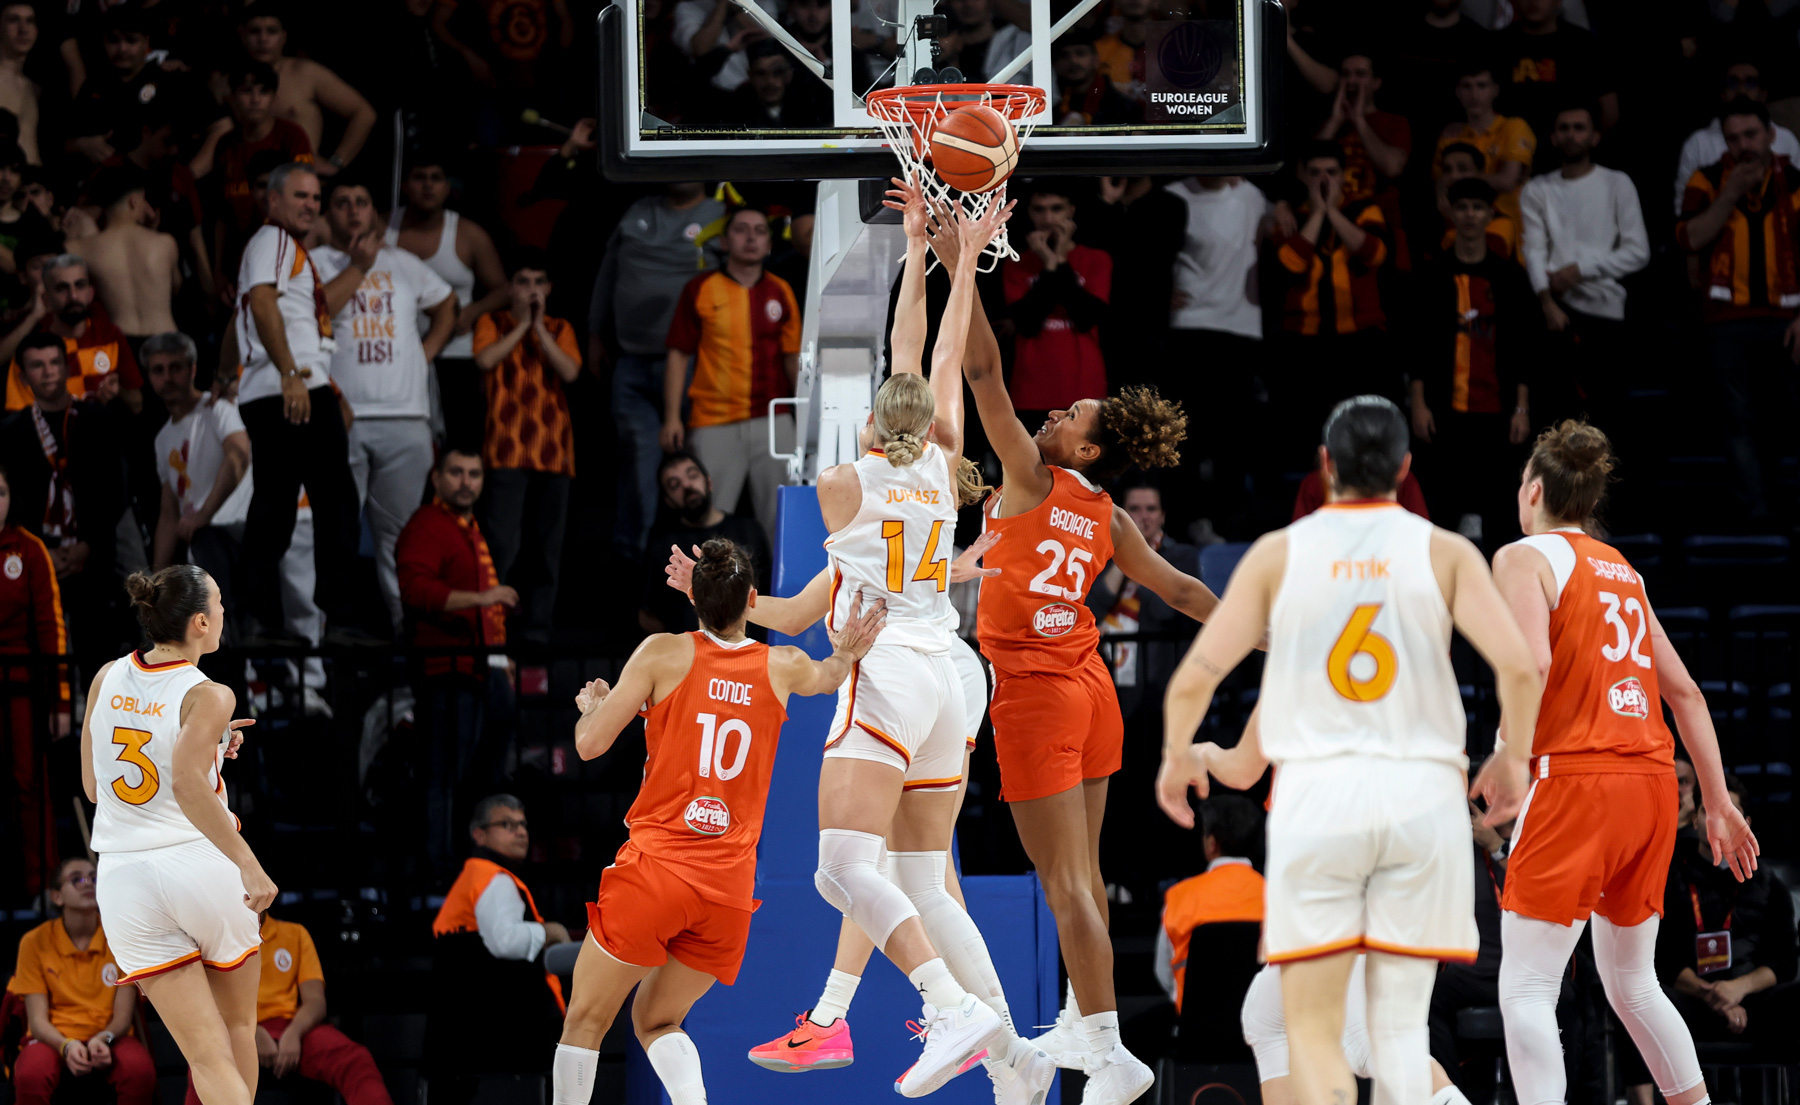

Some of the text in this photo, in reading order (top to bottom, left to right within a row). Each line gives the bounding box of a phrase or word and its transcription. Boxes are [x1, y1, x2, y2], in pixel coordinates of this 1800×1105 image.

[1151, 92, 1228, 104] EUROLEAGUE
[1166, 104, 1213, 115] WOMEN
[353, 316, 396, 339] LIKE
[358, 340, 393, 364] US!
[1049, 506, 1099, 540] BADIANE
[881, 520, 948, 594] 14
[1028, 539, 1093, 601] 25
[1035, 610, 1075, 630] Beretta
[1598, 591, 1652, 669] 32
[1326, 602, 1399, 703] 6
[110, 694, 166, 718] OBLAK
[708, 678, 753, 706] CONDE
[696, 712, 752, 782] 10
[111, 726, 160, 806] 3
[684, 801, 728, 827] Beretta
